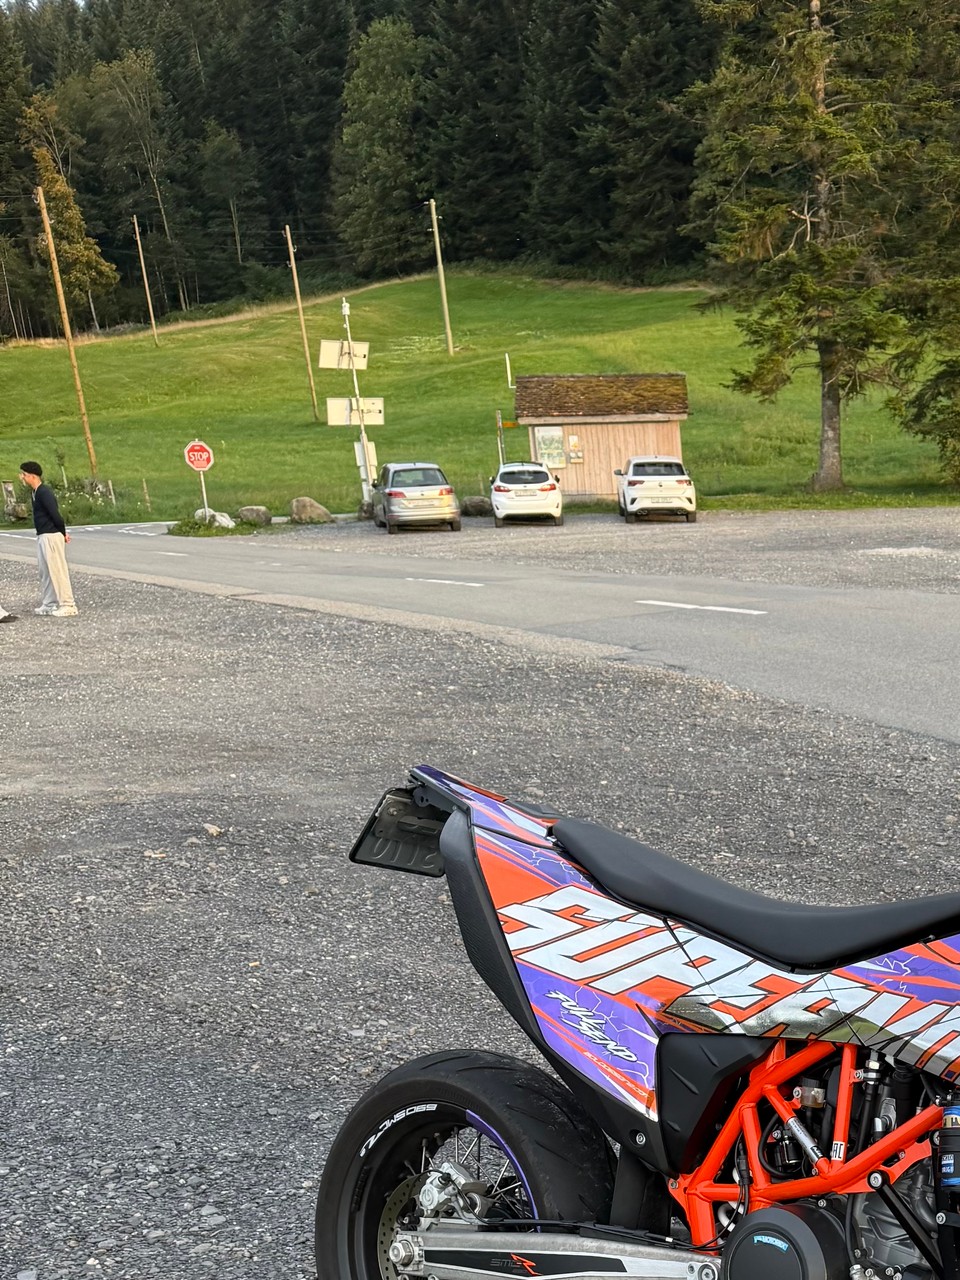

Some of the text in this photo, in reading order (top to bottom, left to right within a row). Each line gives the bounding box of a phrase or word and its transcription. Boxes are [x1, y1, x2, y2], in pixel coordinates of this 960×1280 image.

[189, 451, 209, 462] STOP
[545, 990, 606, 1027] FULL
[560, 1015, 638, 1062] SEND
